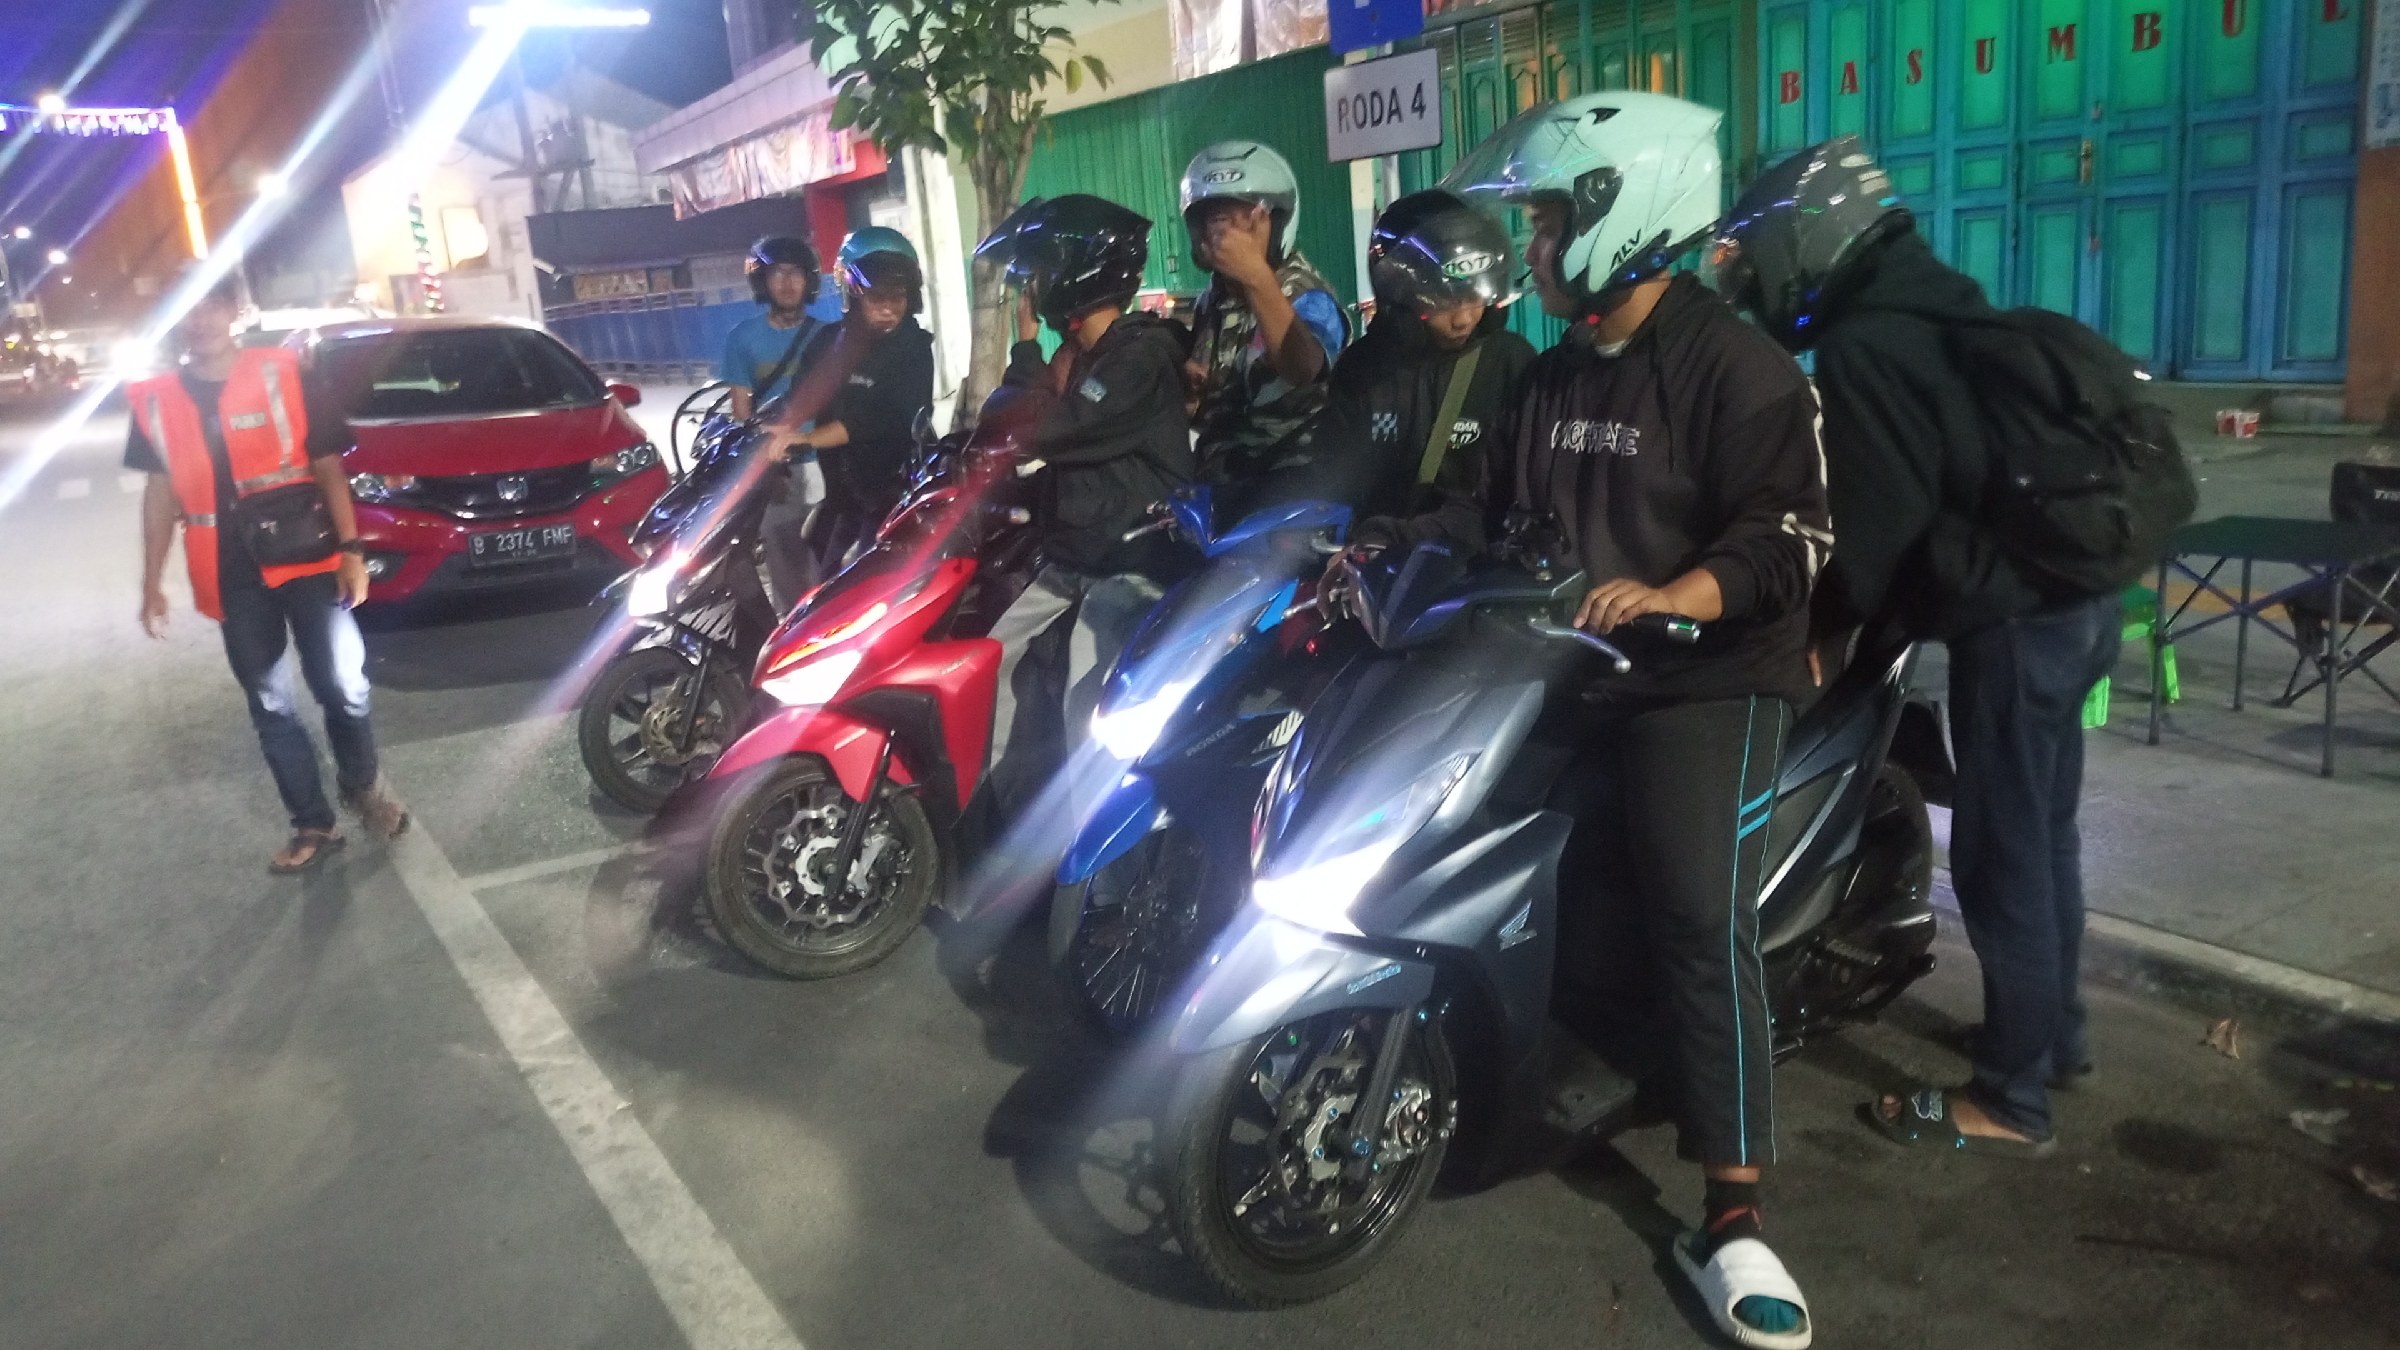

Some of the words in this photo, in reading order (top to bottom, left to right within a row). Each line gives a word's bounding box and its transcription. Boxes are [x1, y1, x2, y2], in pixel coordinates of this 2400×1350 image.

[1337, 86, 1404, 133] RODA
[1411, 82, 1426, 120] 4
[473, 535, 485, 555] B
[496, 532, 534, 552] 2374
